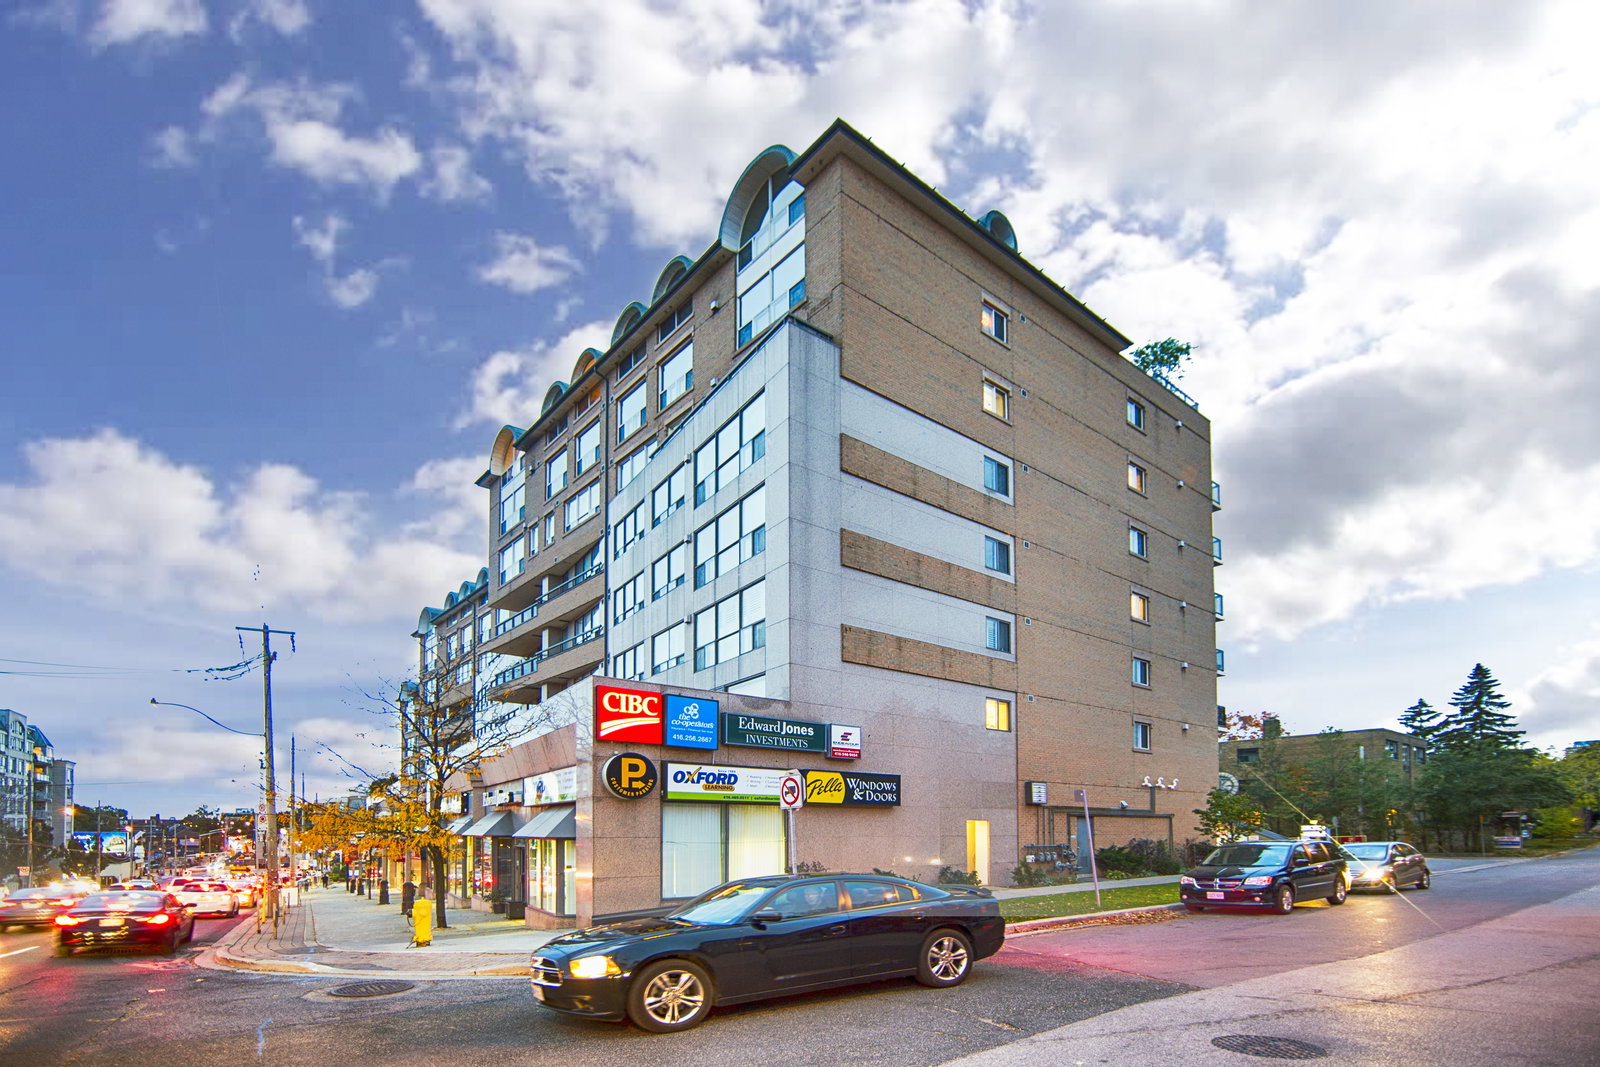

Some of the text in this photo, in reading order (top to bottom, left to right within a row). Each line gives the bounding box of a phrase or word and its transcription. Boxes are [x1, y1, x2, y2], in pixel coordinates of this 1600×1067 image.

[602, 692, 659, 716] CIBC
[738, 716, 815, 736] Edward Jones
[745, 733, 809, 749] INVESTMENTS
[621, 757, 647, 788] P
[672, 767, 738, 785] OXFORD
[807, 777, 843, 800] Pella
[846, 777, 897, 792] WINDOWS
[853, 788, 897, 803] & DOORS
